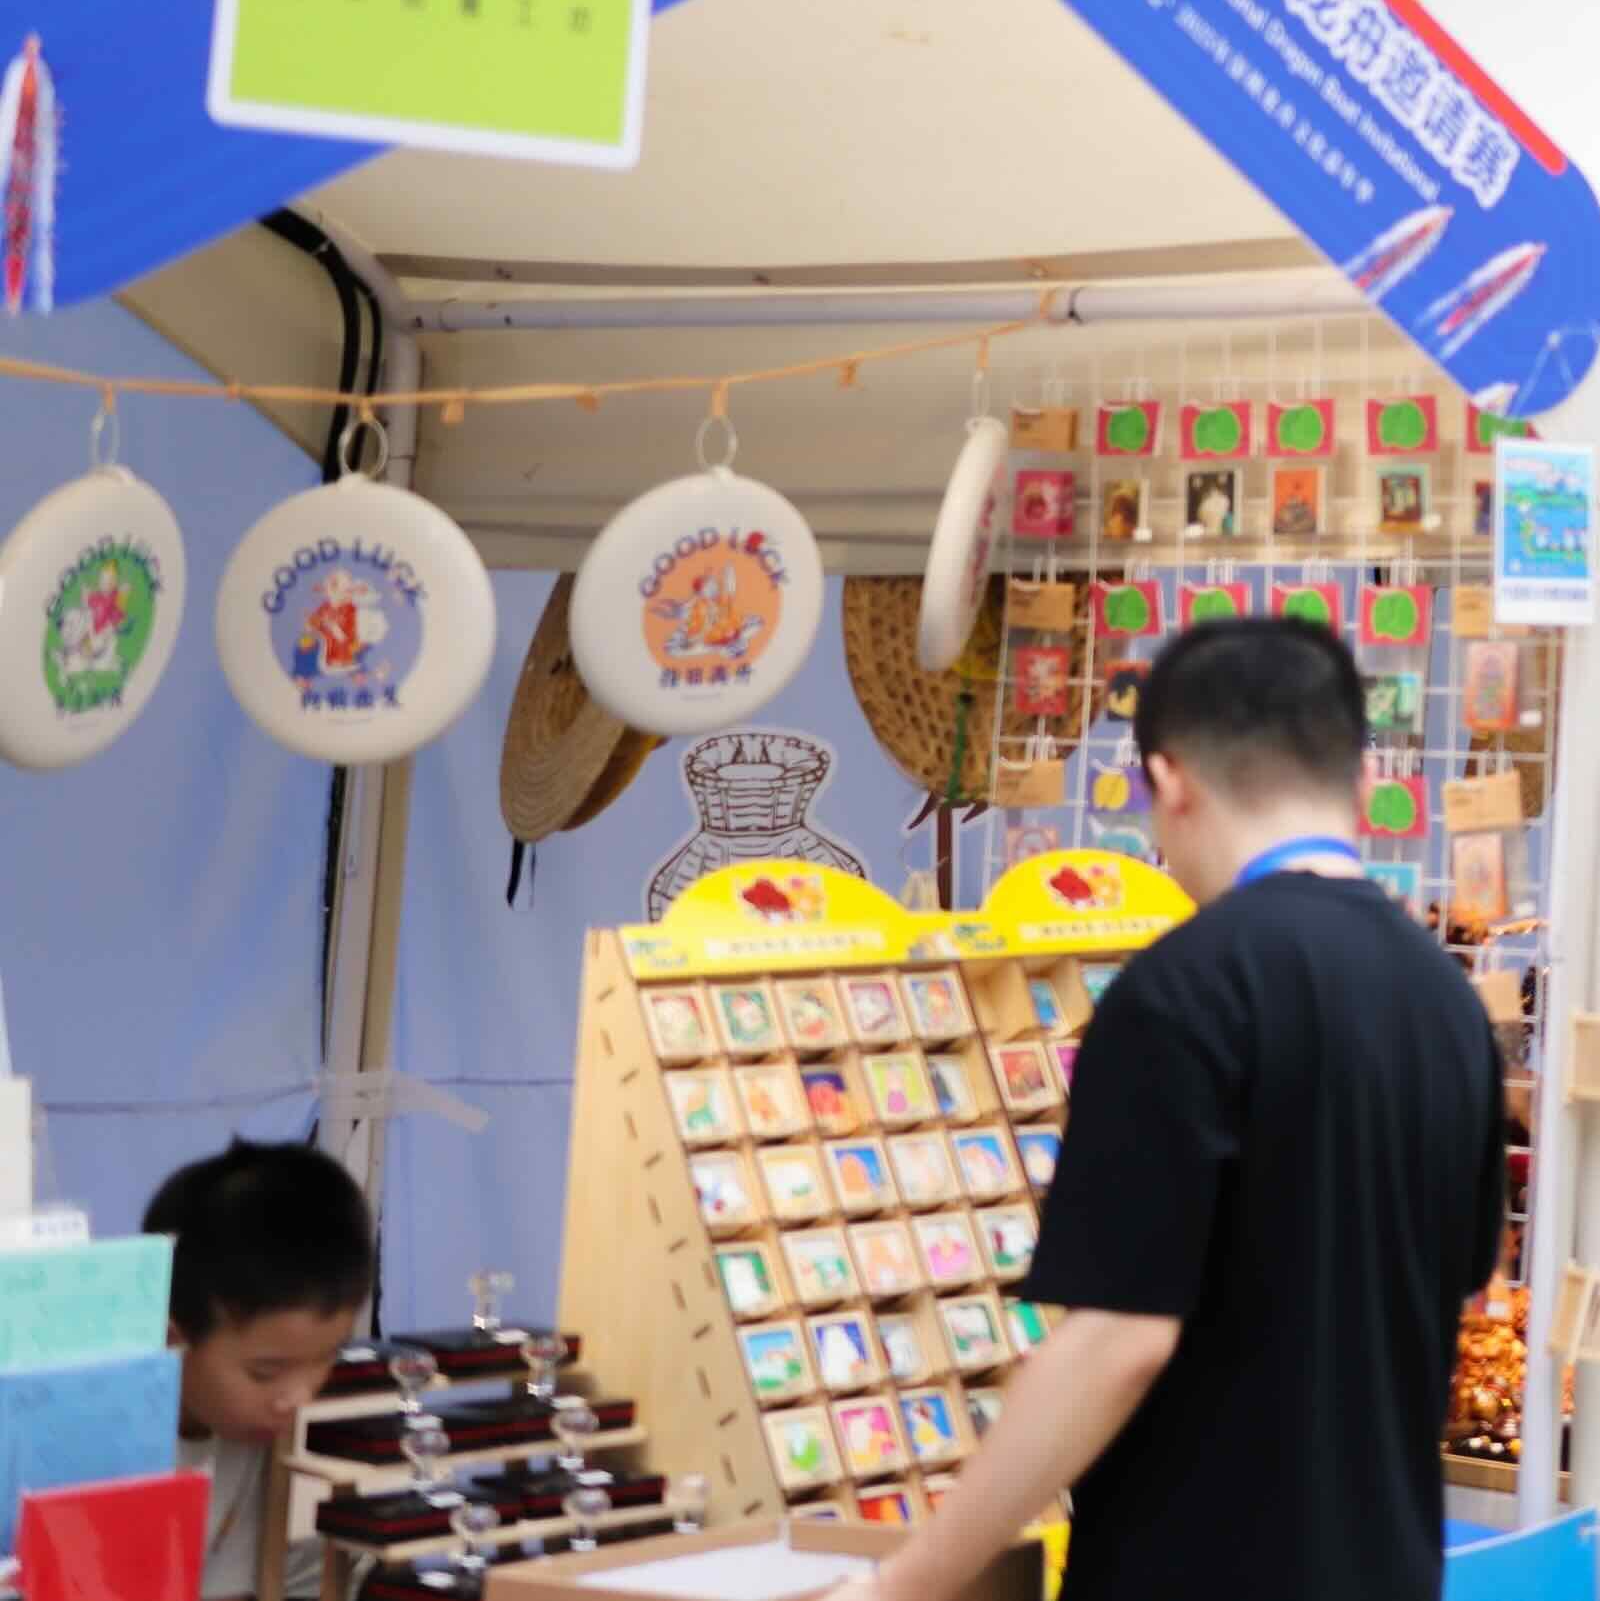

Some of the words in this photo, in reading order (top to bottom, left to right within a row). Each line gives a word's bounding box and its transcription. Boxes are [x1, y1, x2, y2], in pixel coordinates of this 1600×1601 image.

[262, 536, 341, 614] GOOD
[353, 535, 428, 608] LUCK
[639, 526, 720, 599] GOOD
